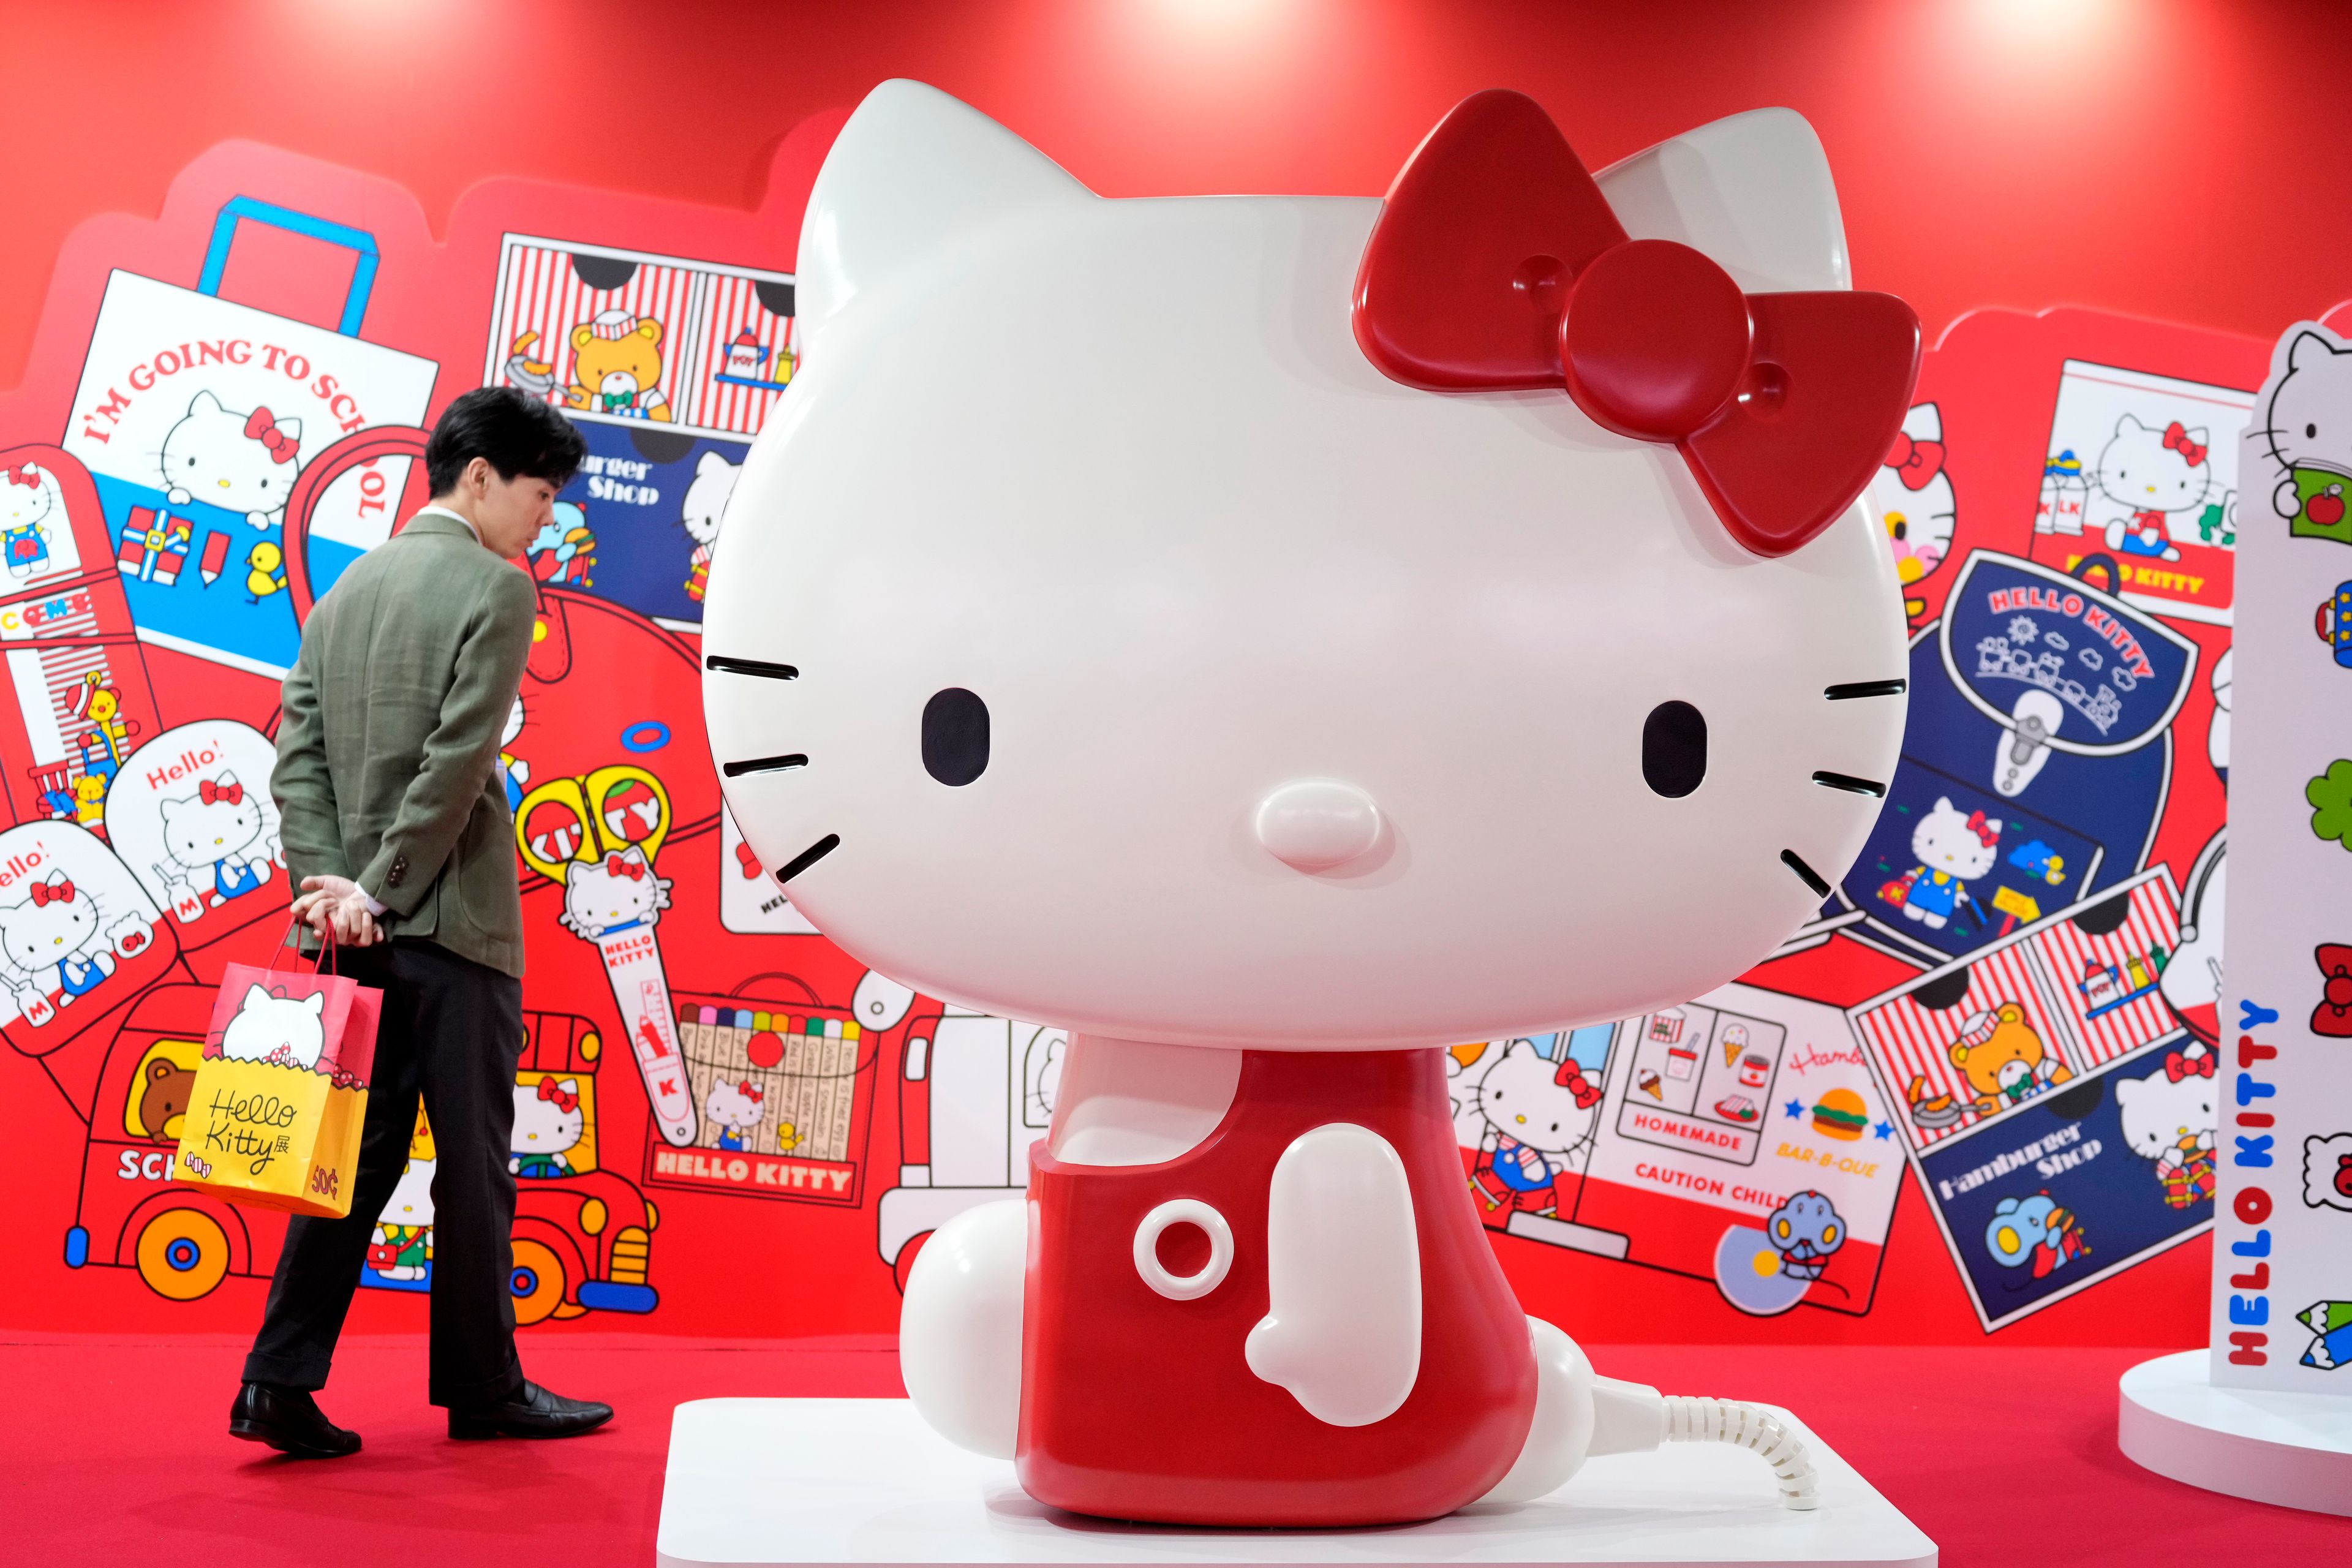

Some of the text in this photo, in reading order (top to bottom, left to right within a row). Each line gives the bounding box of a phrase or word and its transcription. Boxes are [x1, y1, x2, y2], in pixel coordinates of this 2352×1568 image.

[84, 388, 131, 445] I'M
[129, 340, 252, 391] GOING
[262, 344, 311, 380] TO
[587, 475, 659, 506] Shop
[2135, 567, 2204, 594] KITTY
[1988, 586, 2155, 678] HELLO KITTY
[146, 739, 224, 790] Hello!
[179, 896, 200, 916] M
[605, 934, 652, 956] HELLO
[608, 947, 654, 968] KITTY
[28, 1001, 48, 1021] M
[658, 1077, 678, 1097] K
[209, 1088, 297, 1128] Hello
[205, 1120, 275, 1175] Kitty
[1634, 1113, 1742, 1150] HOMEMADE
[655, 1151, 853, 1192] HELLO KITTY
[1776, 1142, 1880, 1178] BAR-B-QUE
[1939, 1121, 2082, 1201] Hamburger
[2035, 1139, 2103, 1180] Shop
[311, 1164, 338, 1201] 50¢
[1635, 1163, 1725, 1195] CAUTION
[2228, 999, 2279, 1366] HELLO KITTY
